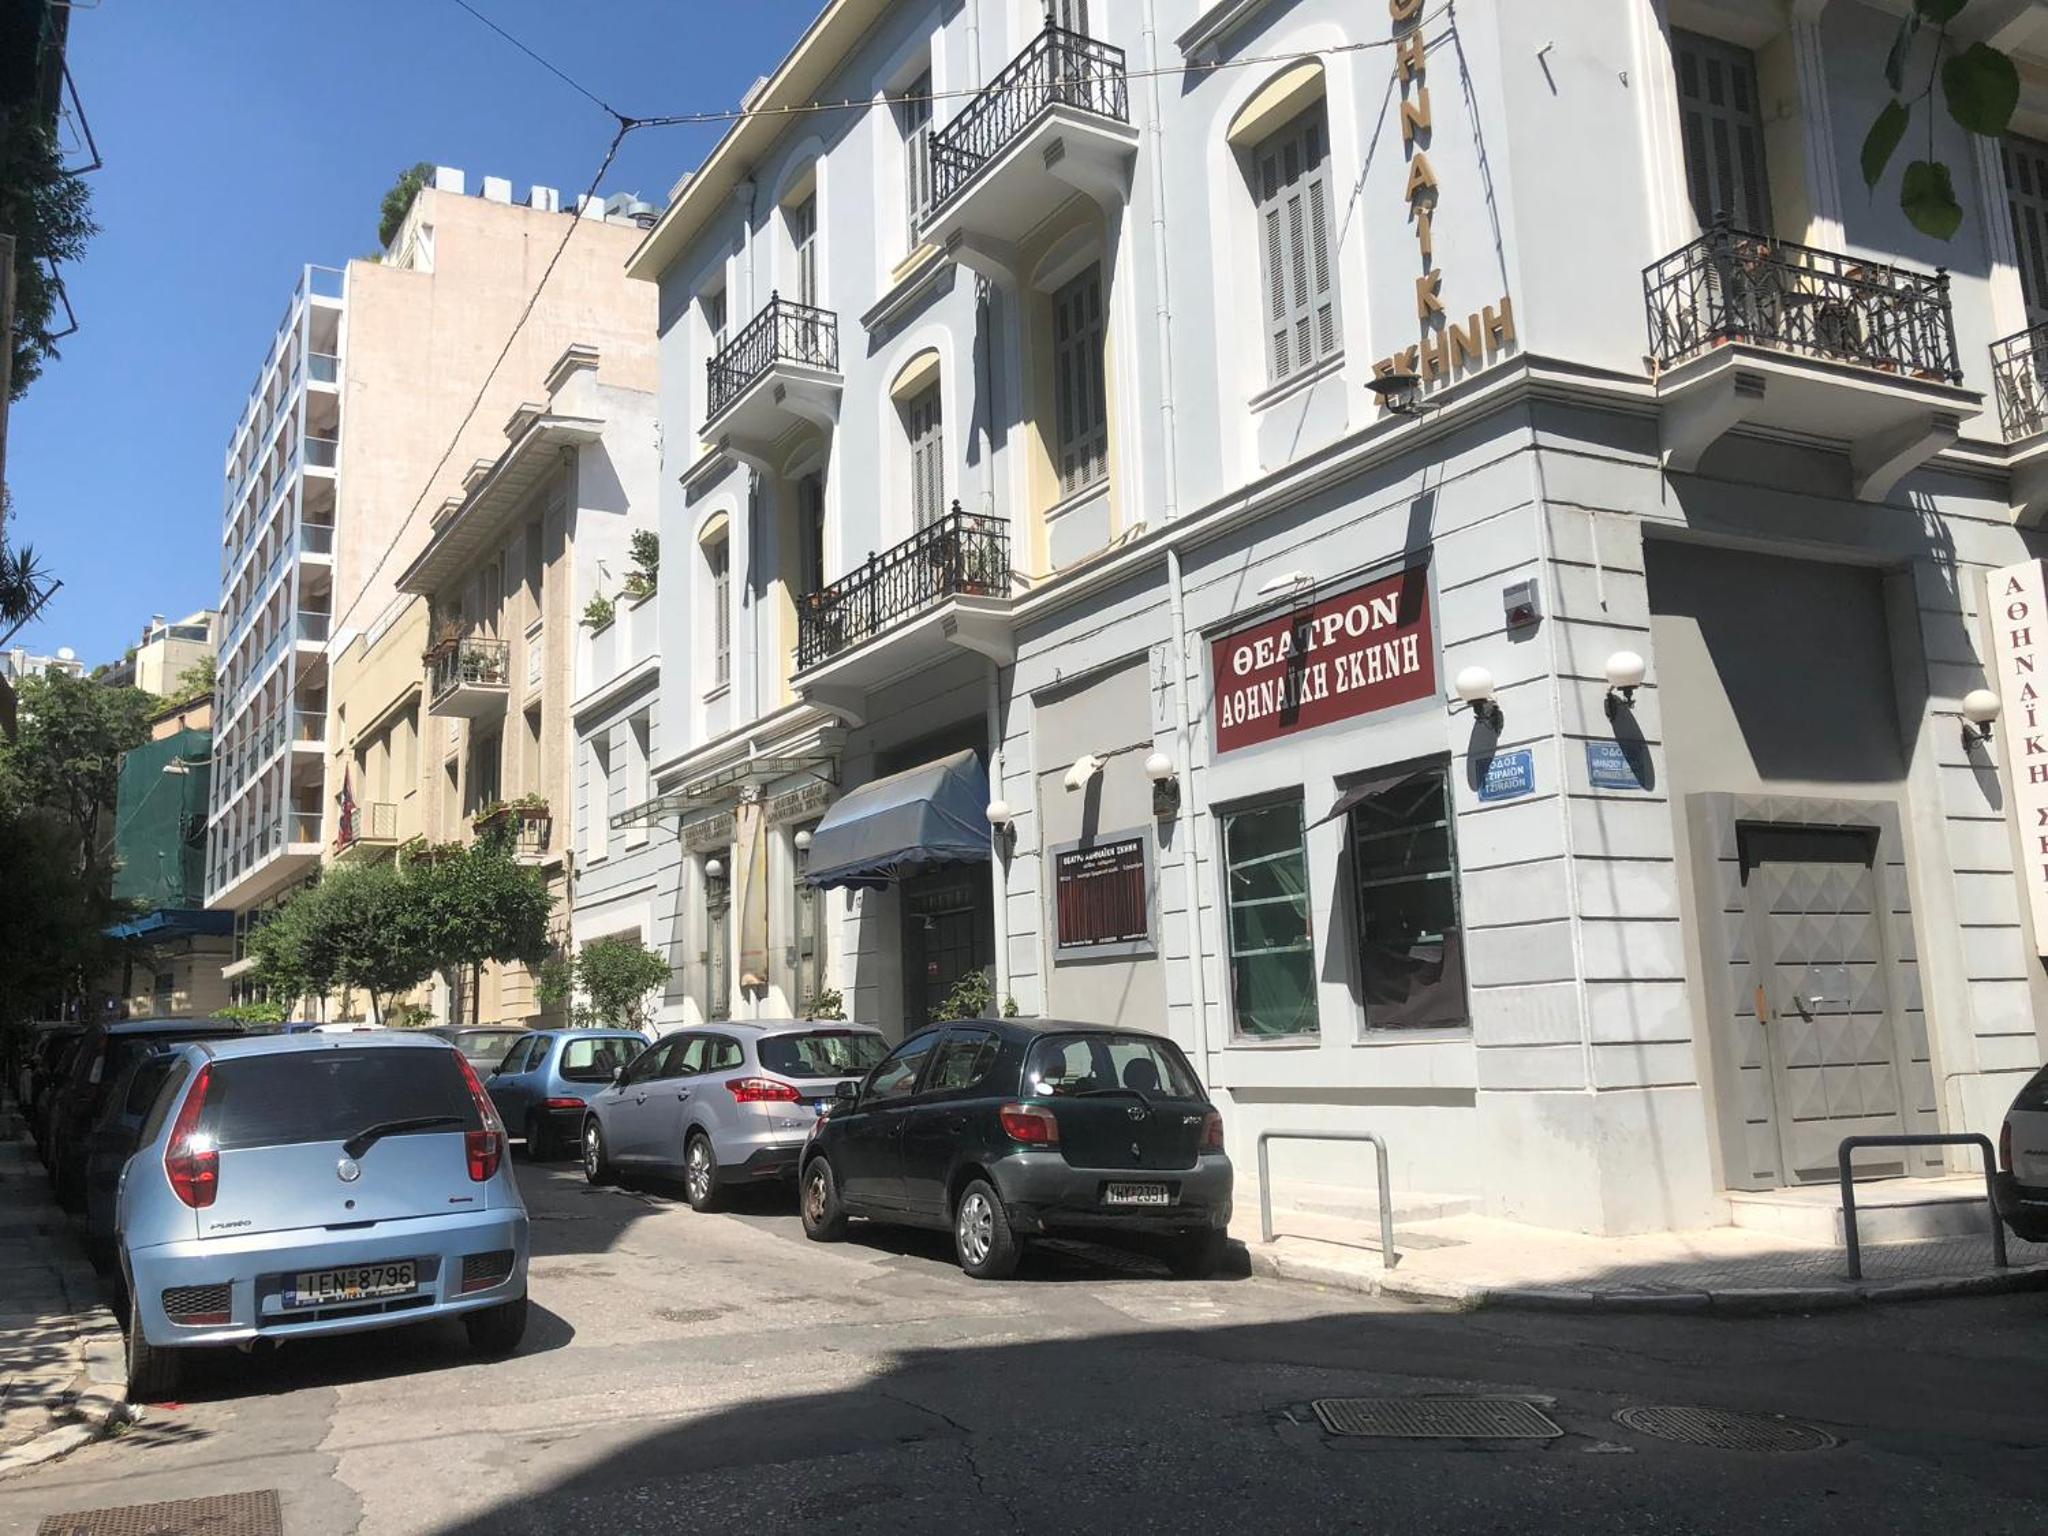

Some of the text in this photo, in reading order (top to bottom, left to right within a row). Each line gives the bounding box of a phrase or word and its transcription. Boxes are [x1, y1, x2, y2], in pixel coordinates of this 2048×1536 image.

[1232, 592, 1399, 676] ΘΕΑΤΡΟΝ
[1221, 633, 1421, 728] ΑΘΗΝΑΪΚΗ ΣΚΗΝΗ
